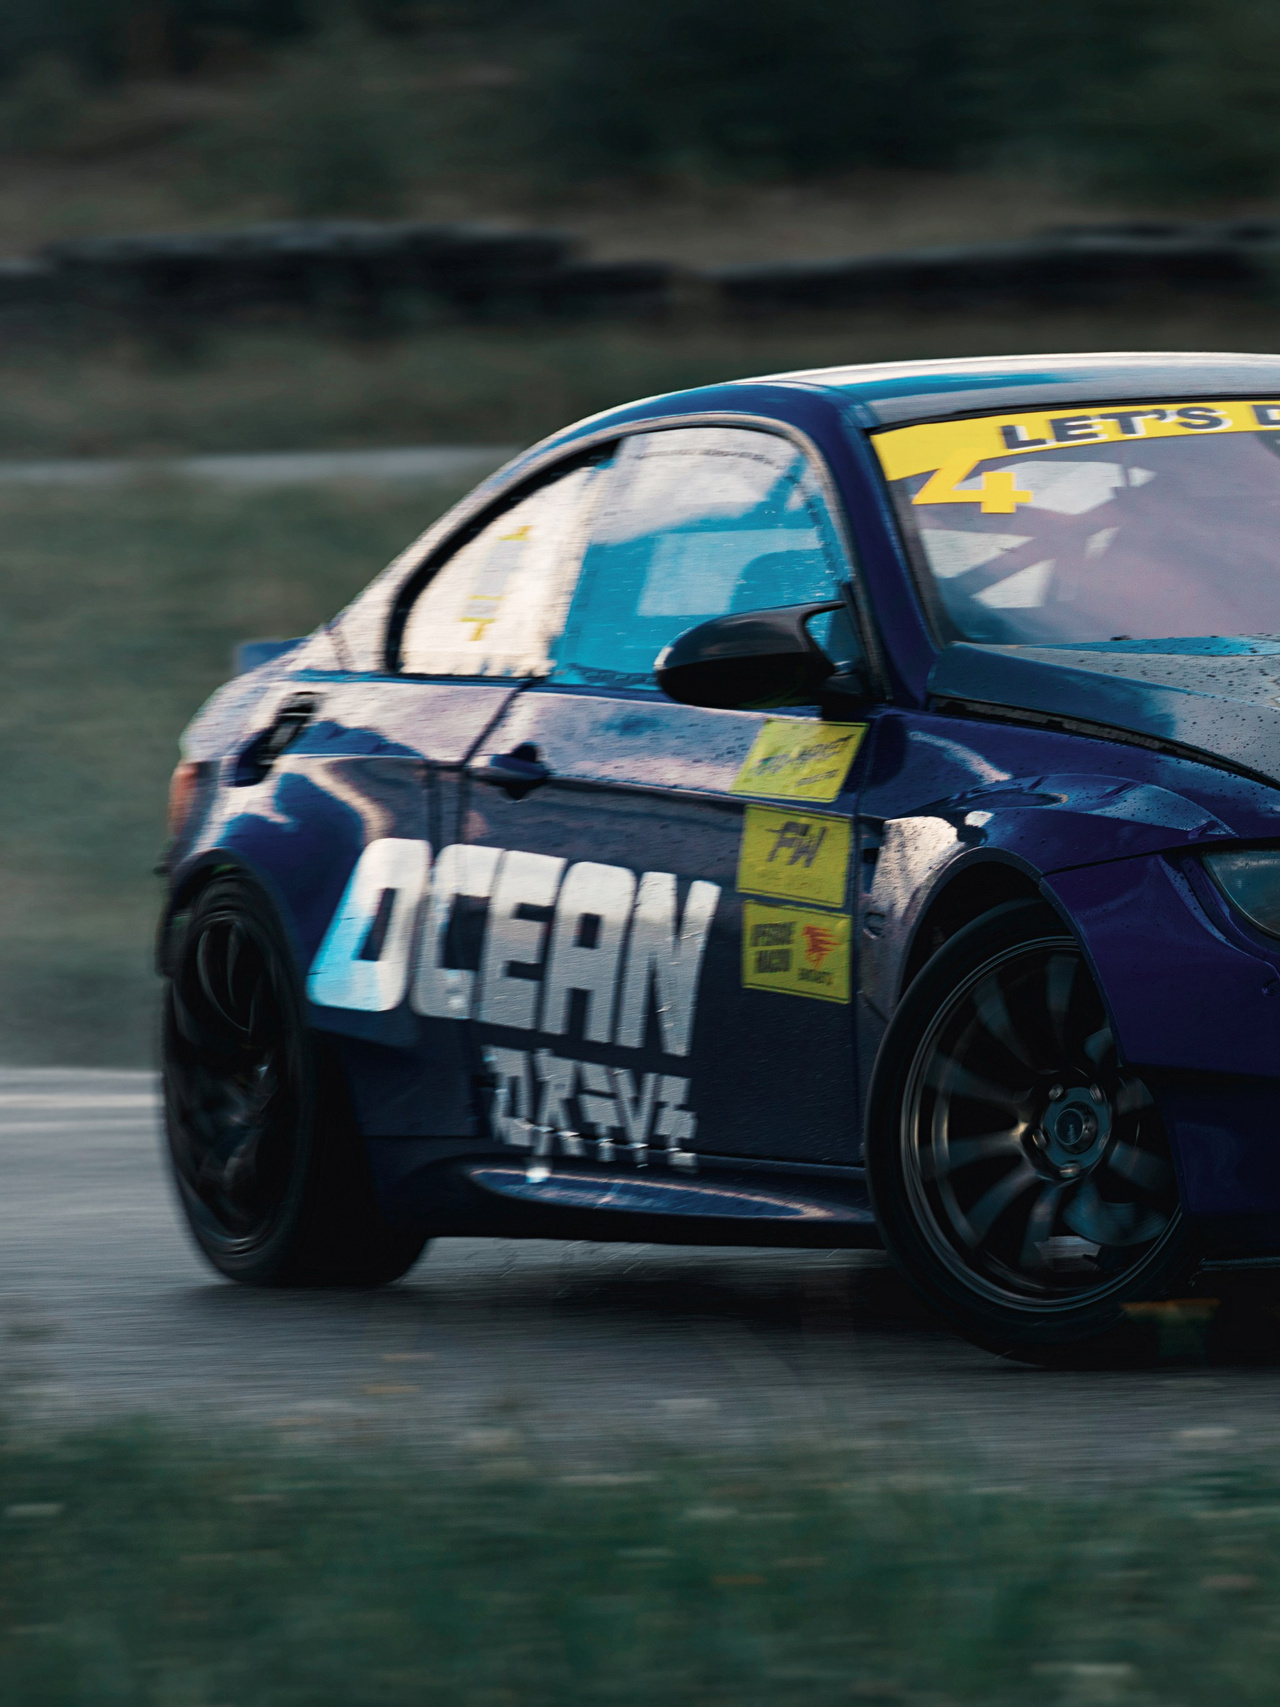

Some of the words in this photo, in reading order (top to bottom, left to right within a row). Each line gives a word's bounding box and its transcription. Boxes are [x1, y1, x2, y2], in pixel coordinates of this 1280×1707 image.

[999, 406, 1232, 451] LET'S
[911, 446, 1034, 514] 4
[306, 837, 722, 1058] OCEAN
